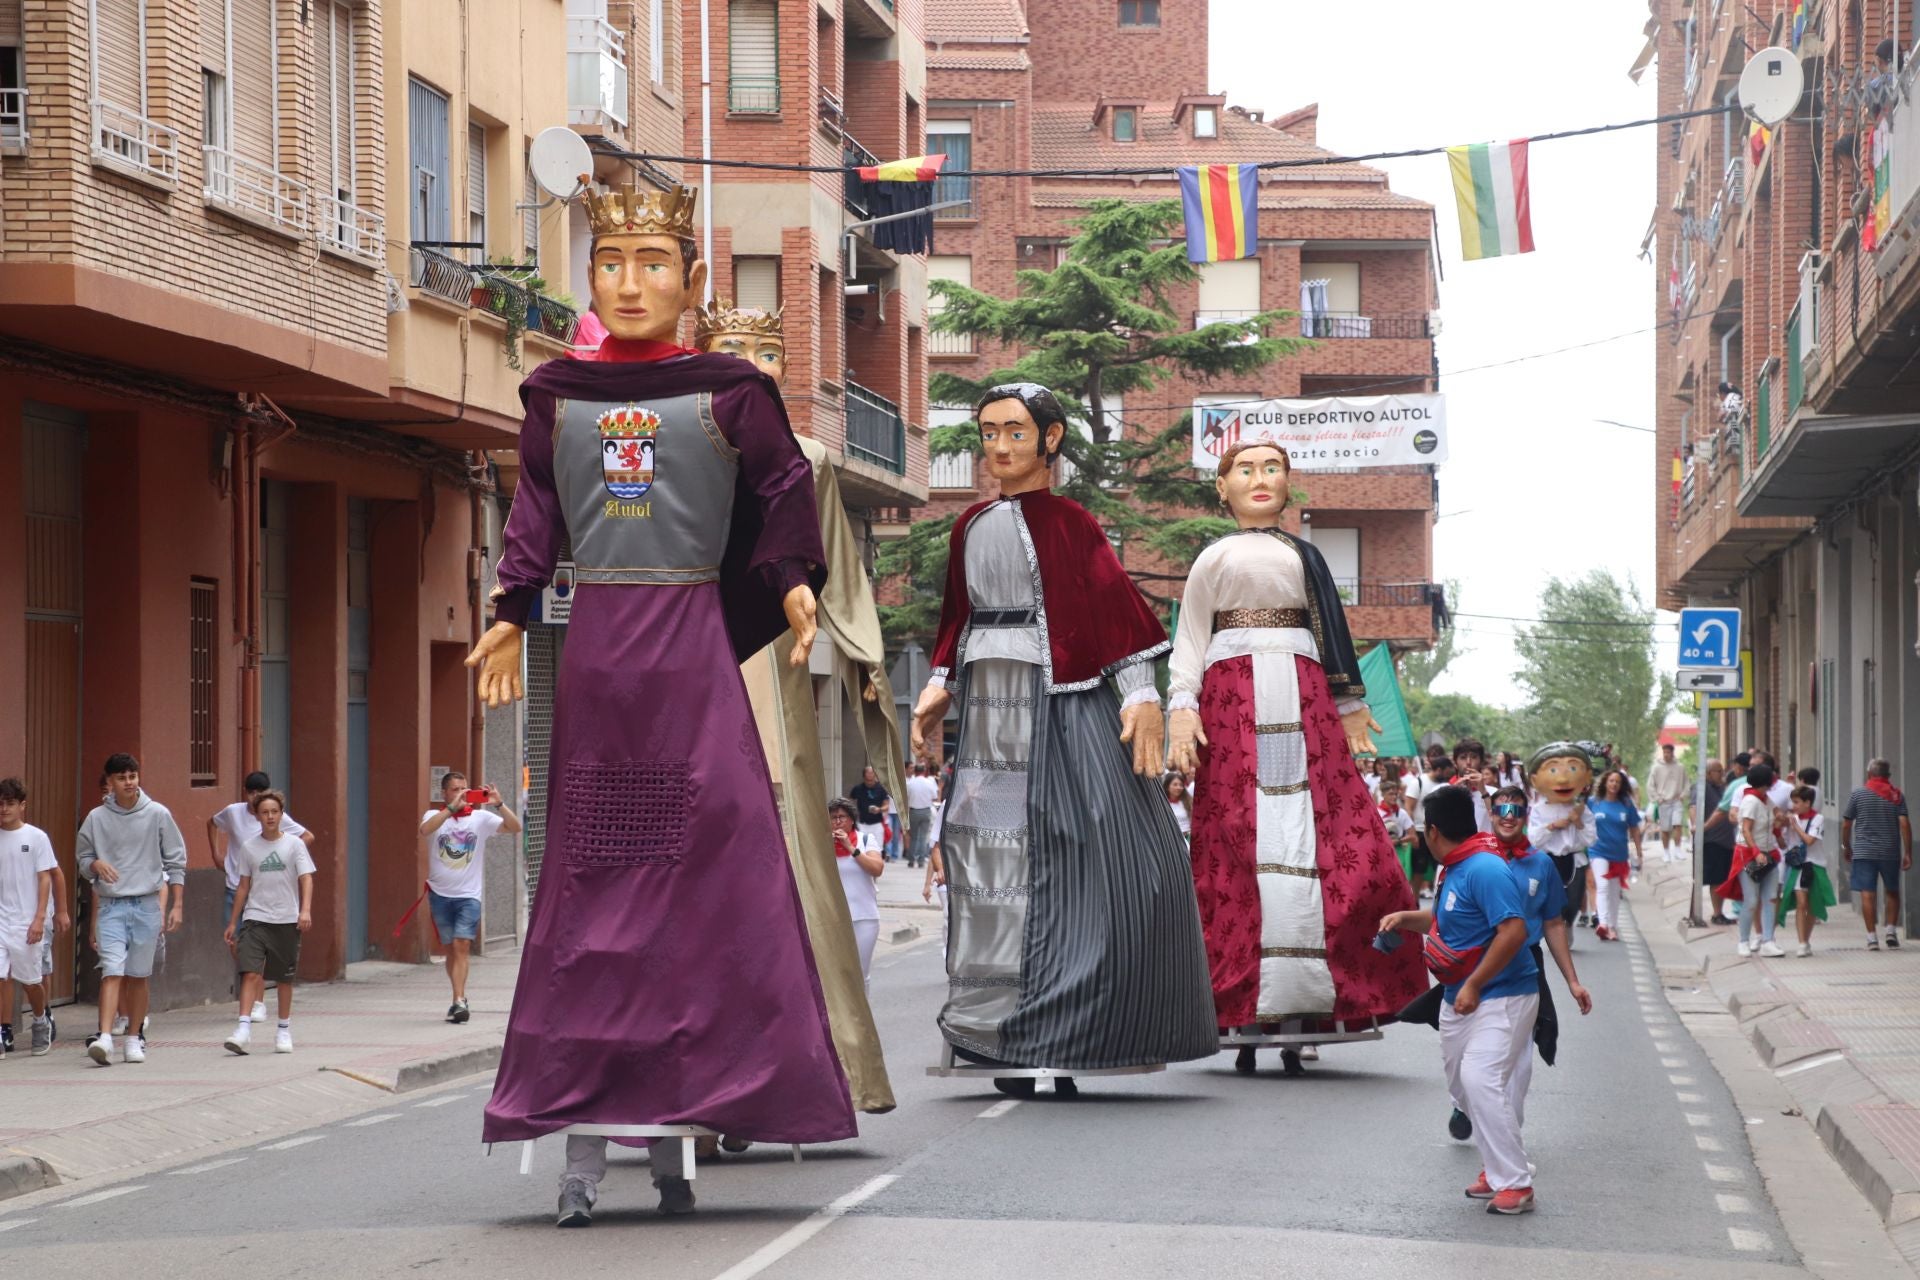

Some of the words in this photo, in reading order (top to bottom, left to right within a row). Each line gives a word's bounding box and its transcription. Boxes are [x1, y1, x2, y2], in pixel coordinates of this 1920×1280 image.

[1245, 412, 1283, 424] CLUB
[1288, 411, 1375, 424] DEPORTIVO
[1380, 408, 1432, 421] AUTOL
[1314, 430, 1348, 442] felices
[1352, 426, 1405, 441] fiestas!!!
[1284, 447, 1328, 459] azte
[1334, 446, 1379, 458] socio
[605, 500, 651, 517] Autol
[1684, 649, 1700, 657] 40
